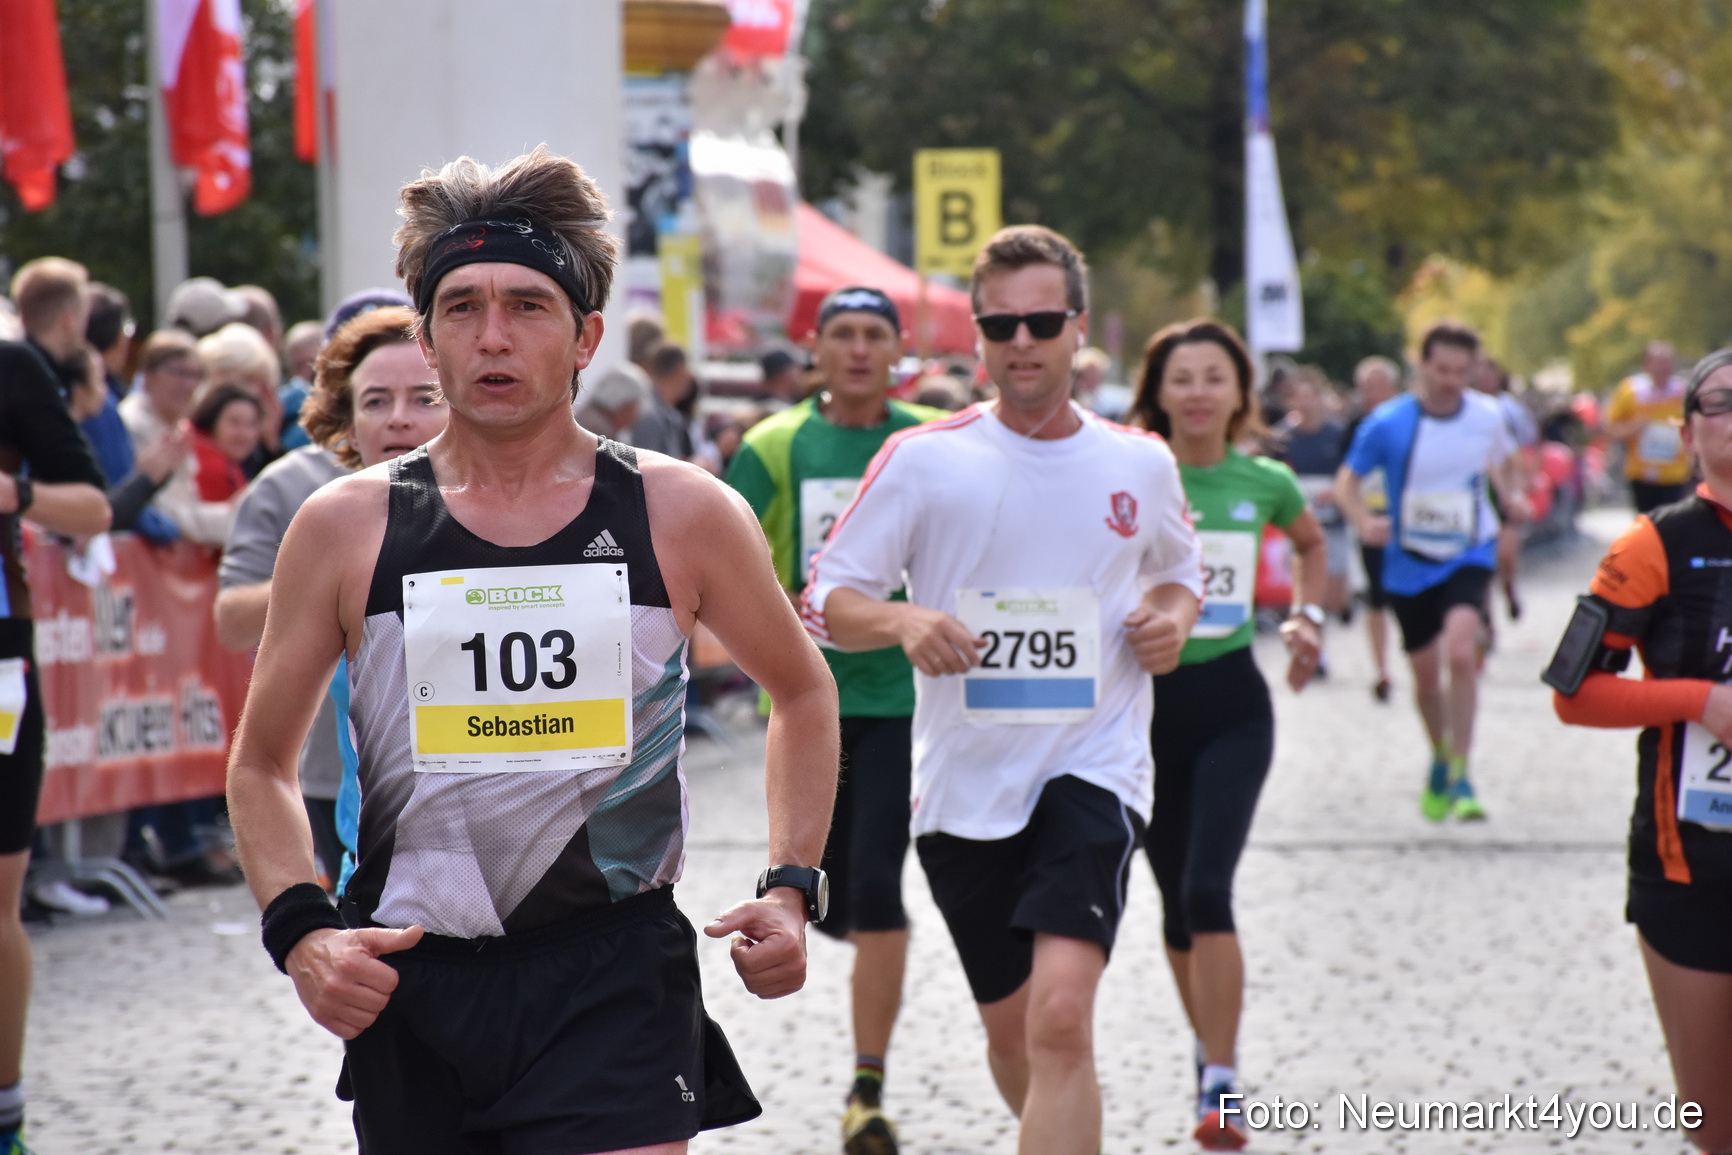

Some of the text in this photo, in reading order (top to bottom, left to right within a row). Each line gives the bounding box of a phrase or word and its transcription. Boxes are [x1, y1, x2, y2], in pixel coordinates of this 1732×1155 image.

[939, 190, 976, 247] B
[583, 545, 624, 558] adidas
[487, 585, 564, 604] BOCK
[461, 629, 578, 692] 103
[980, 630, 1077, 669] 2795
[420, 686, 428, 697] C
[467, 714, 574, 737] Sebastian
